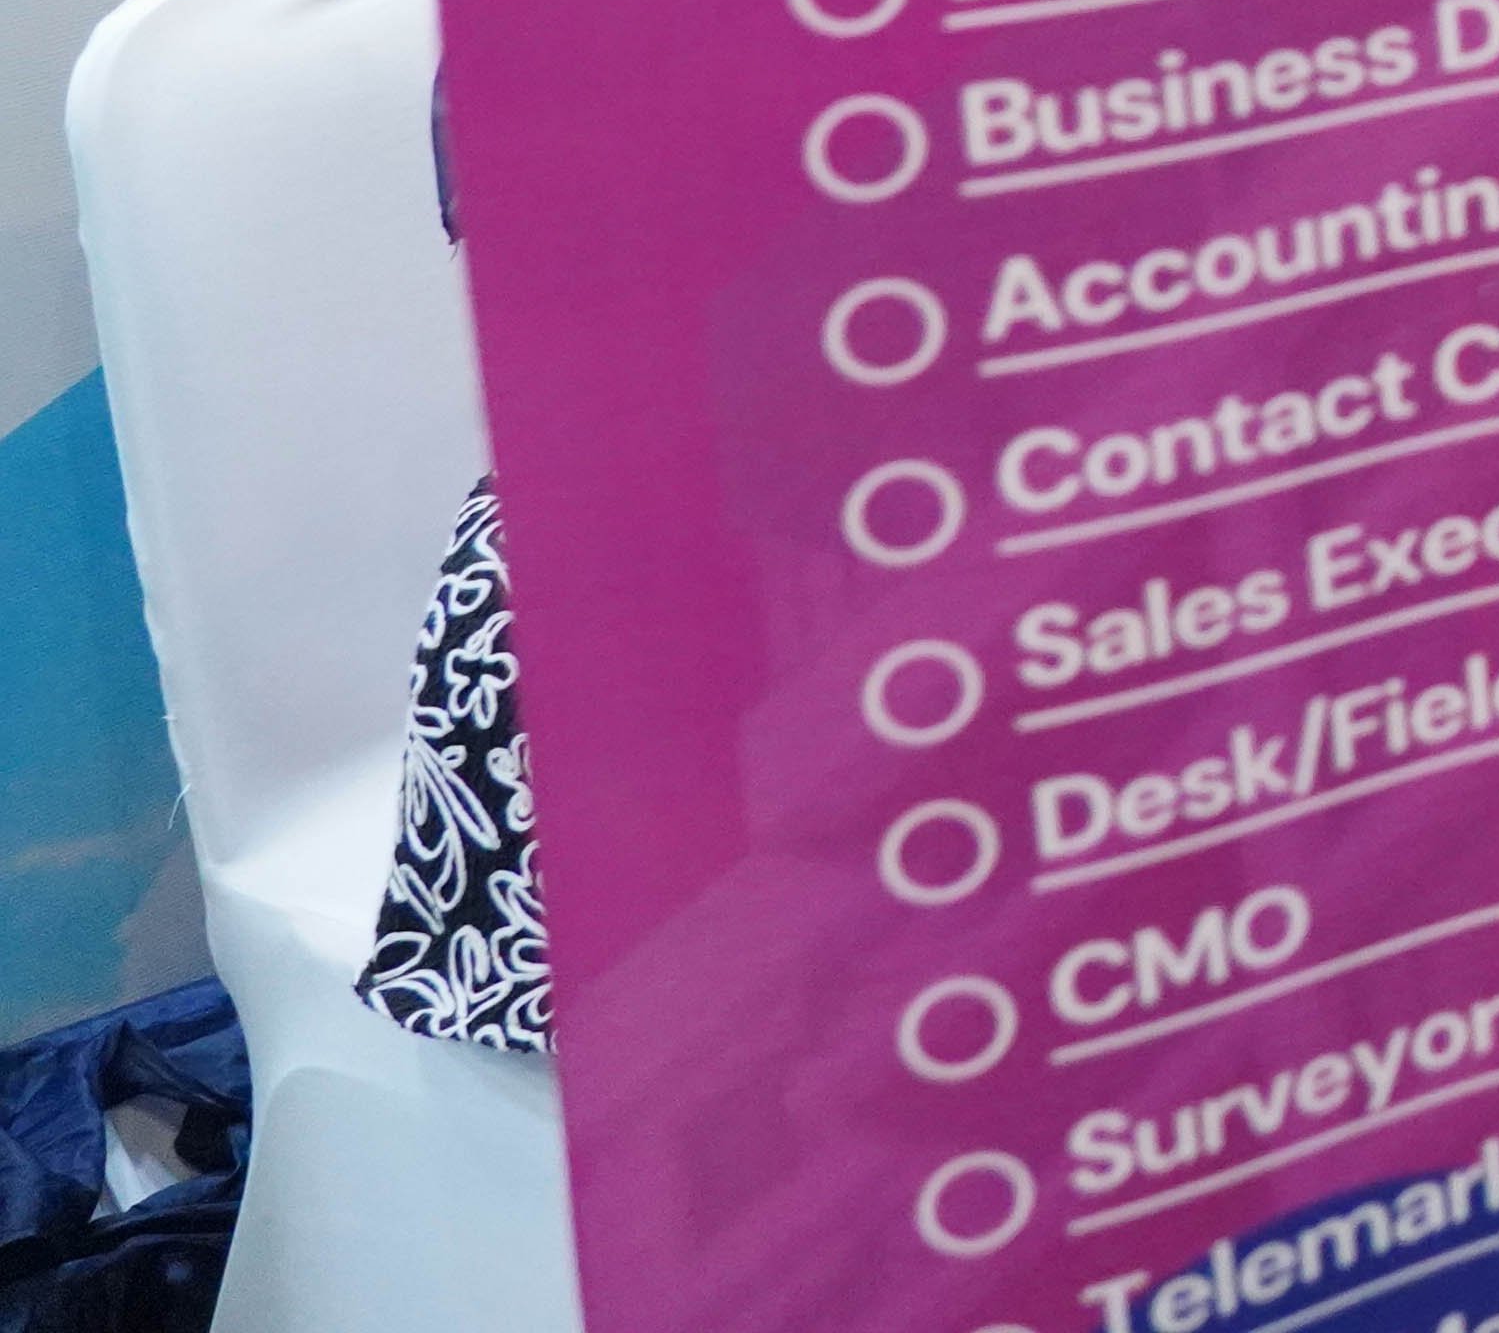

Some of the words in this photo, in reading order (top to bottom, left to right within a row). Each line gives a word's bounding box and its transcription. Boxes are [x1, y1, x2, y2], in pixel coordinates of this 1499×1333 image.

[962, 20, 1416, 165] Business
[997, 355, 1415, 514] Contact
[1017, 560, 1289, 689] Sales
[1049, 885, 1310, 1028] CMO
